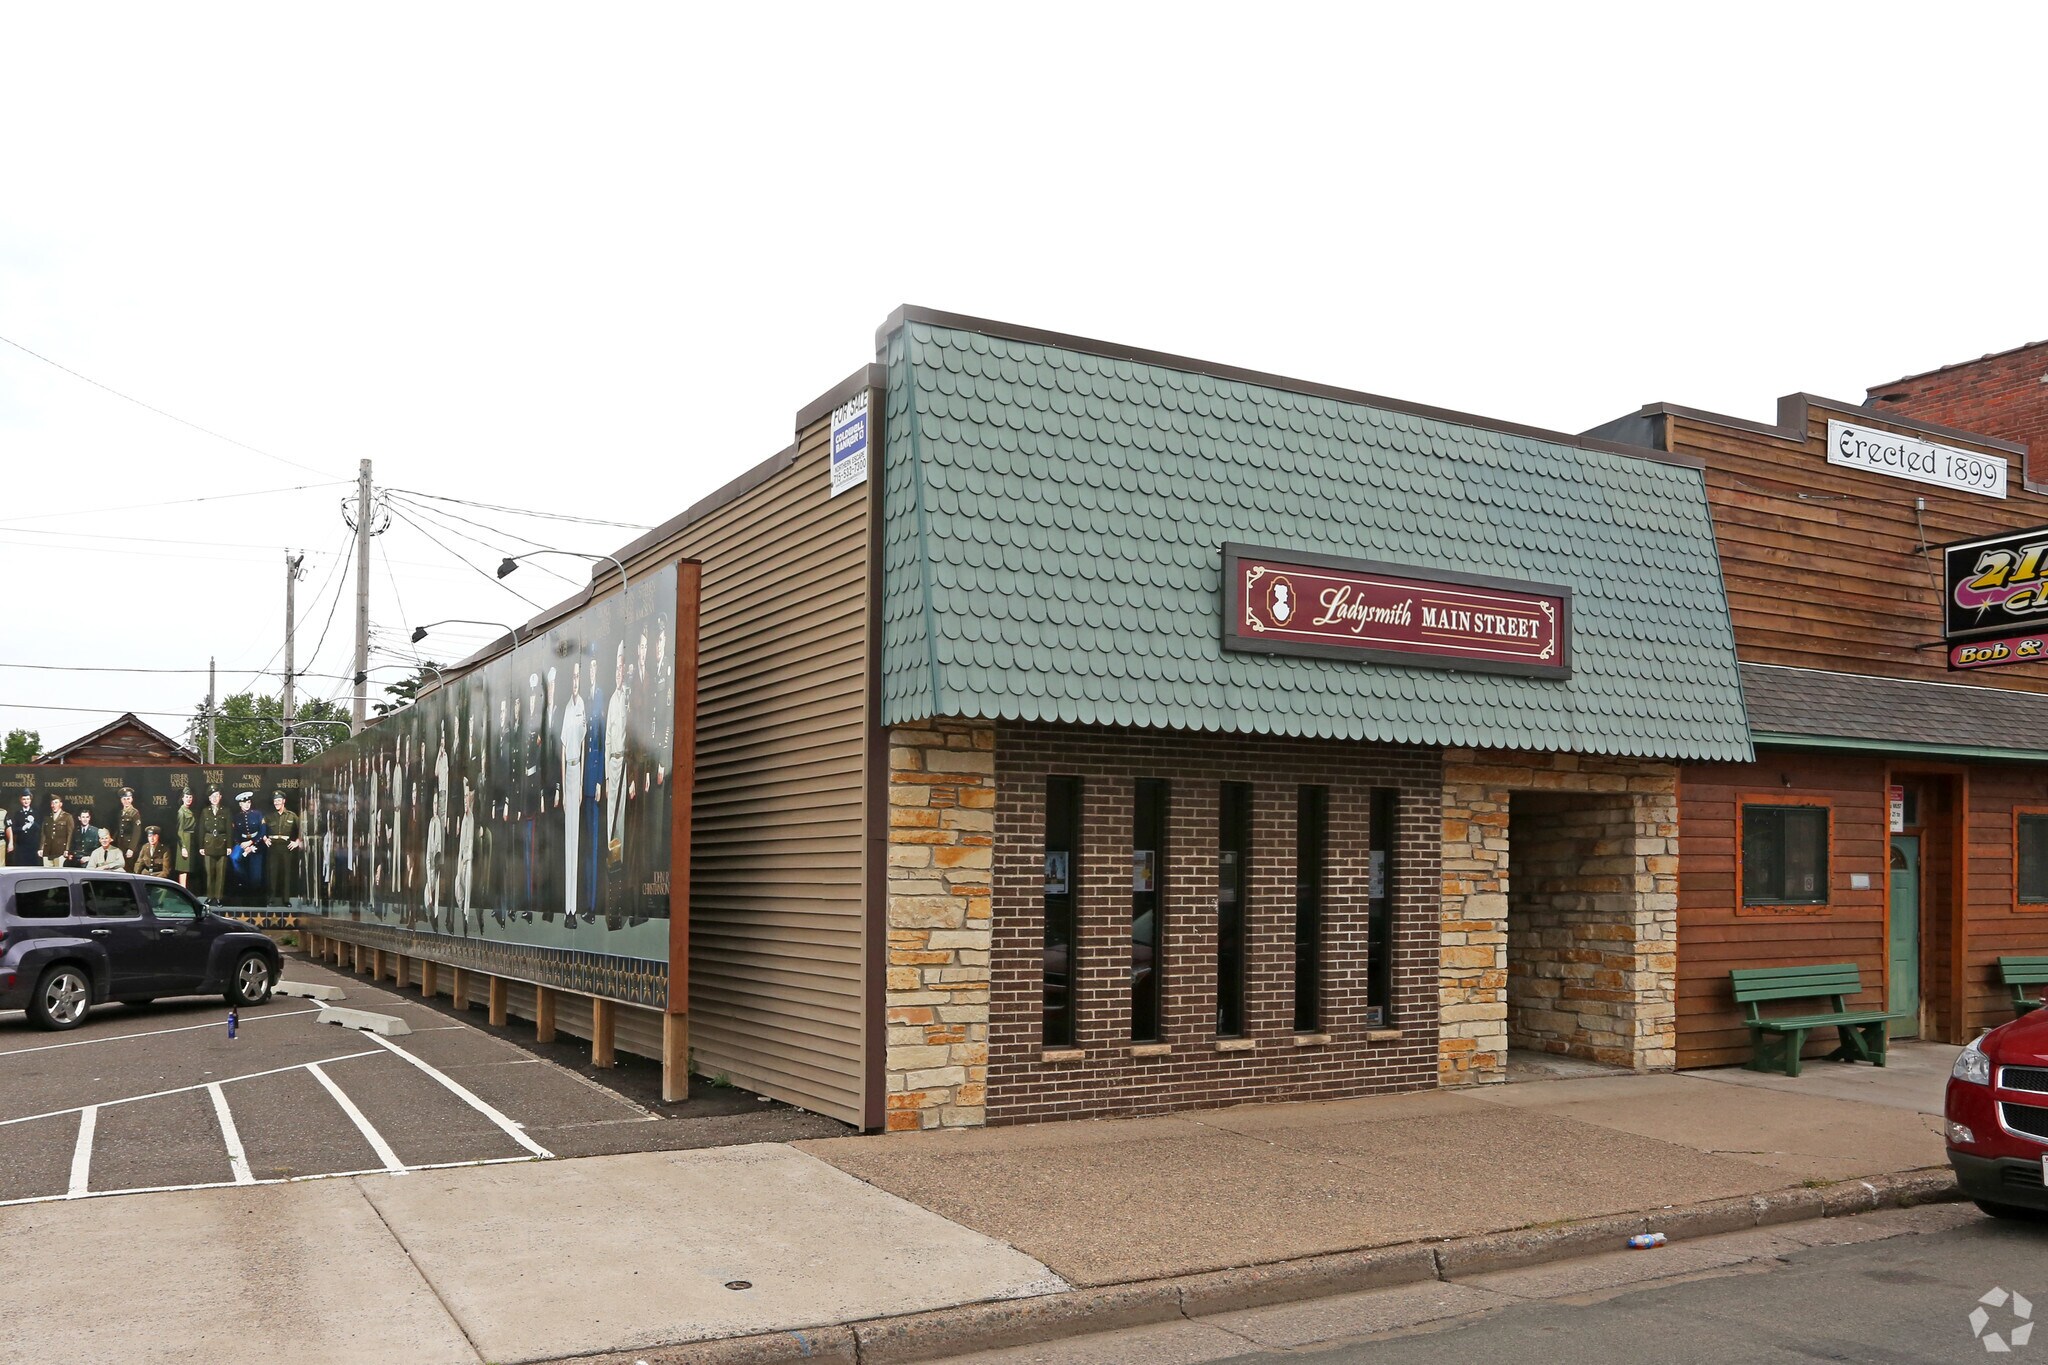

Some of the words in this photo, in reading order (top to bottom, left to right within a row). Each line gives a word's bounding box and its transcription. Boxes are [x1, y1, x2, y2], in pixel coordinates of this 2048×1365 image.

[833, 403, 848, 427] FOR
[850, 390, 868, 416] SALE
[835, 420, 865, 444] COLDWELL
[835, 432, 860, 454] BANKER
[1839, 429, 1937, 476] Erected
[1945, 455, 1998, 490] 1899
[1312, 584, 1413, 634] Ladysmith
[1957, 642, 2011, 665] Bob
[2016, 639, 2043, 657] &
